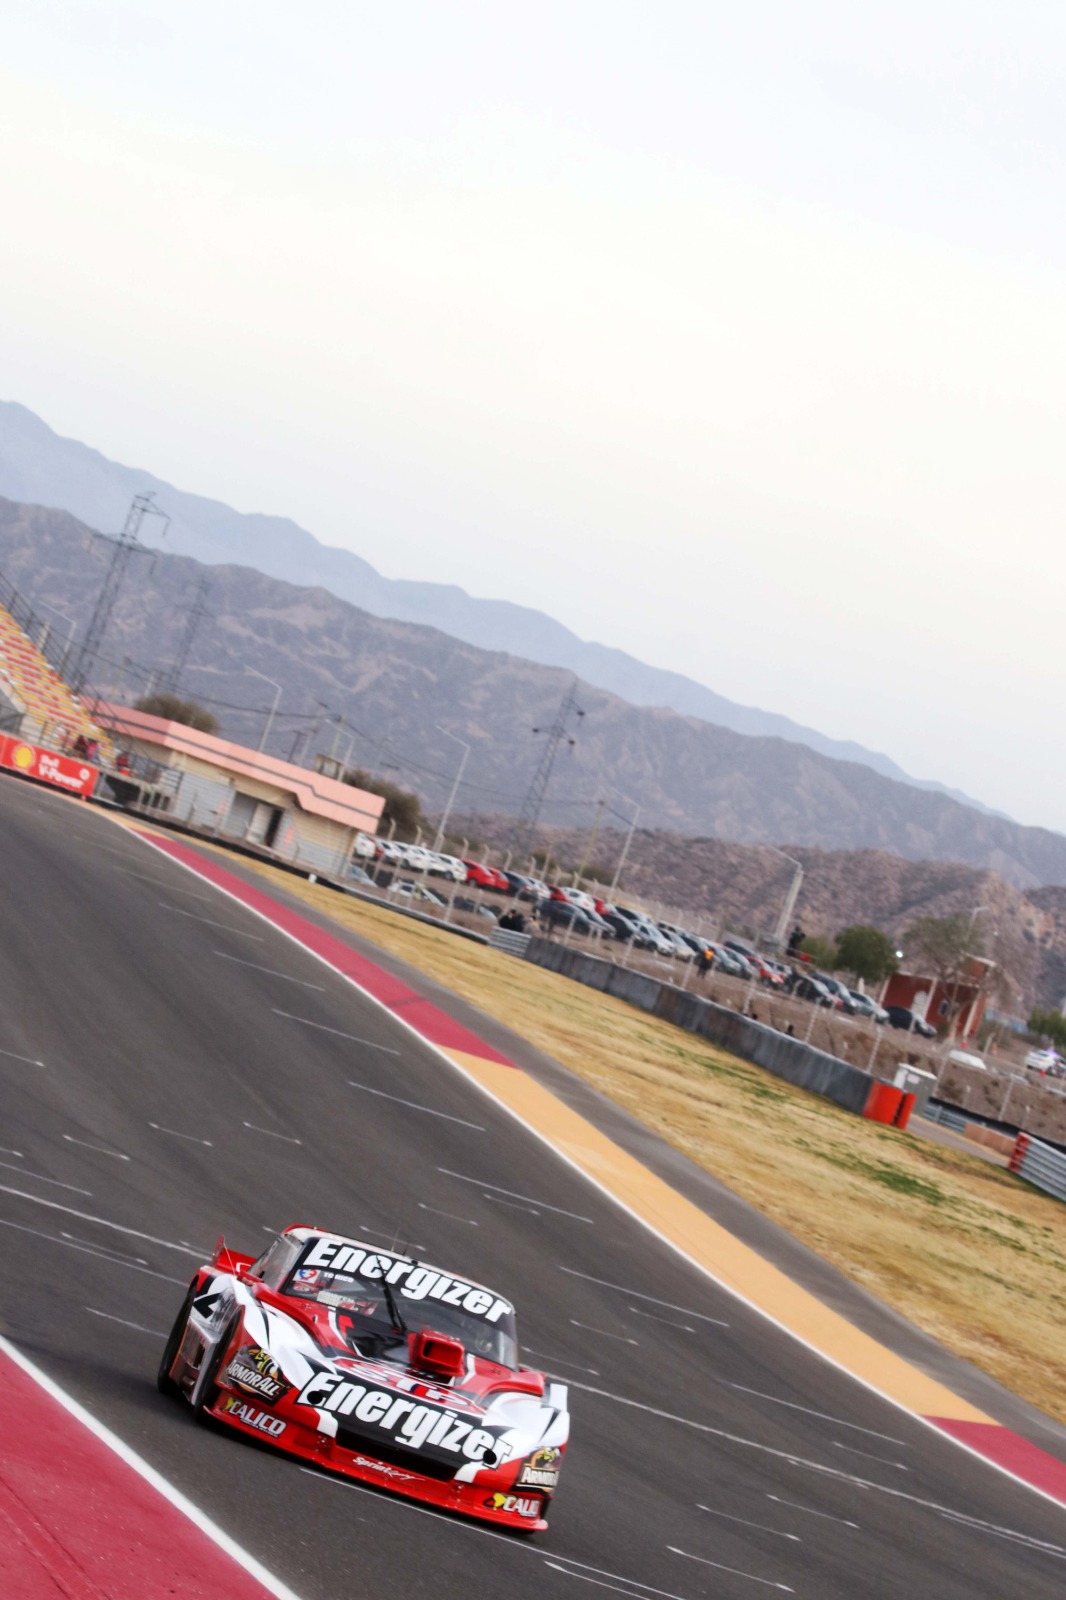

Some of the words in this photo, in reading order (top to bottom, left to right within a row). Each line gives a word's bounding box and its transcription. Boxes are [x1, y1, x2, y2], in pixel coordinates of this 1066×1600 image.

[39, 763, 84, 789] V-Power
[303, 1238, 512, 1323] Energizer
[229, 1401, 287, 1435] CALICO
[296, 1371, 514, 1470] Energizer
